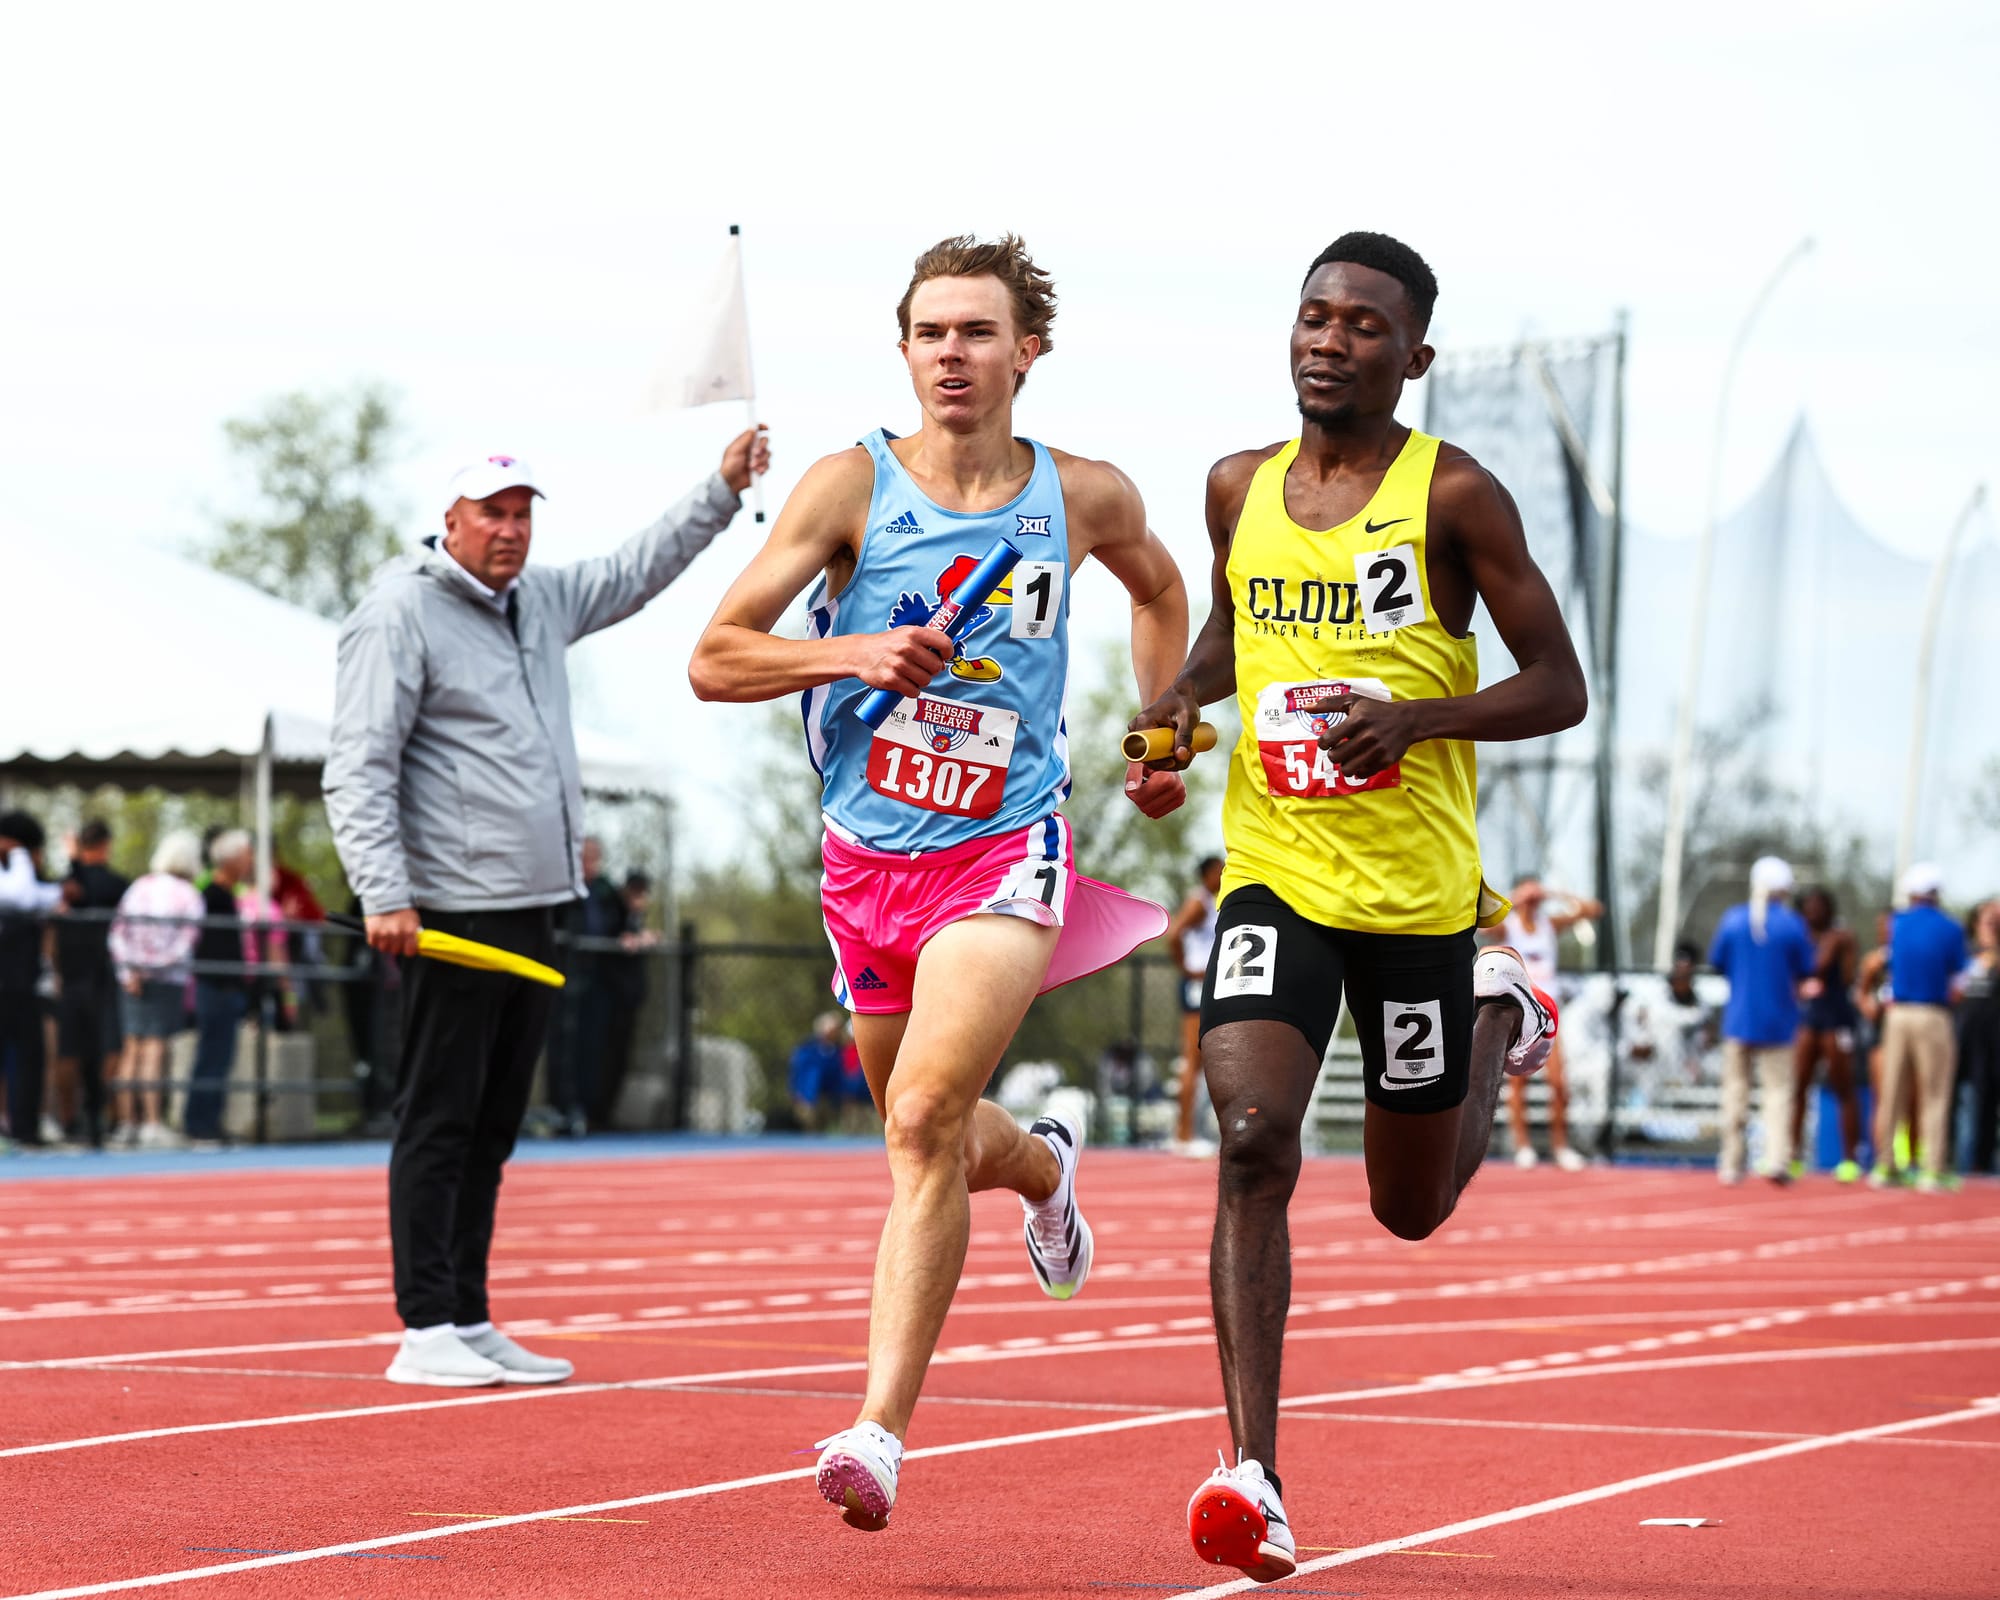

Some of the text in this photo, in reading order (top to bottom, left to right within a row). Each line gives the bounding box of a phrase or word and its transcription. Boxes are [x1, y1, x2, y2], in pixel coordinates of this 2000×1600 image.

[885, 524, 924, 535] adidas
[1026, 572, 1052, 621] 1
[1248, 577, 1366, 624] CLOU
[1367, 558, 1414, 614] 2
[1254, 621, 1299, 638] TRACK
[1313, 626, 1320, 640] &
[1292, 685, 1342, 698] KANSAS
[923, 701, 975, 721] KANSAS
[923, 712, 971, 730] RELAYS
[935, 725, 955, 735] 2024
[879, 746, 992, 810] 1307
[1034, 864, 1058, 907] 1
[1224, 932, 1266, 980] 2
[853, 981, 889, 990] adidas
[1393, 1012, 1436, 1061] 2
